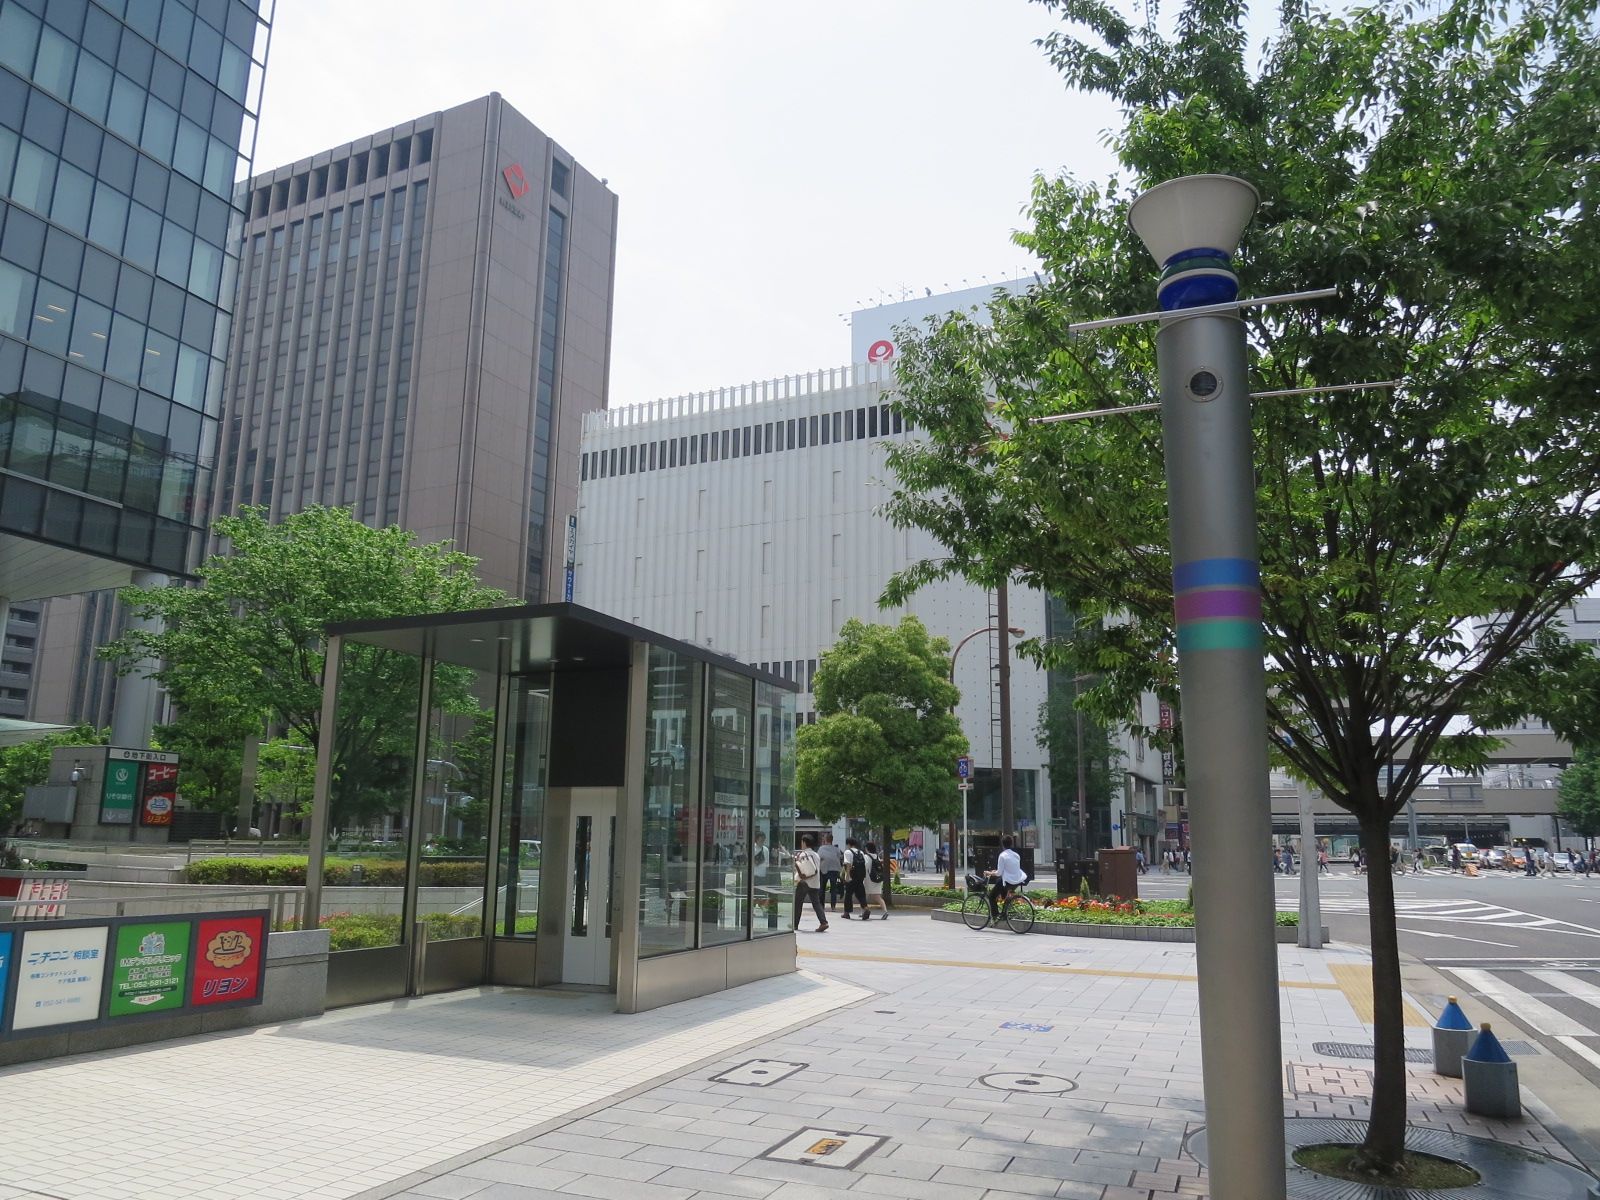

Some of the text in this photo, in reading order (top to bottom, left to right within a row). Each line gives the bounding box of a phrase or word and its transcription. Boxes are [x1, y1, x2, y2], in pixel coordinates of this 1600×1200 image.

[148, 766, 177, 780] コーヒー
[731, 807, 800, 818] Monld's
[147, 815, 170, 823] リヨン
[202, 976, 249, 998] リヨン
